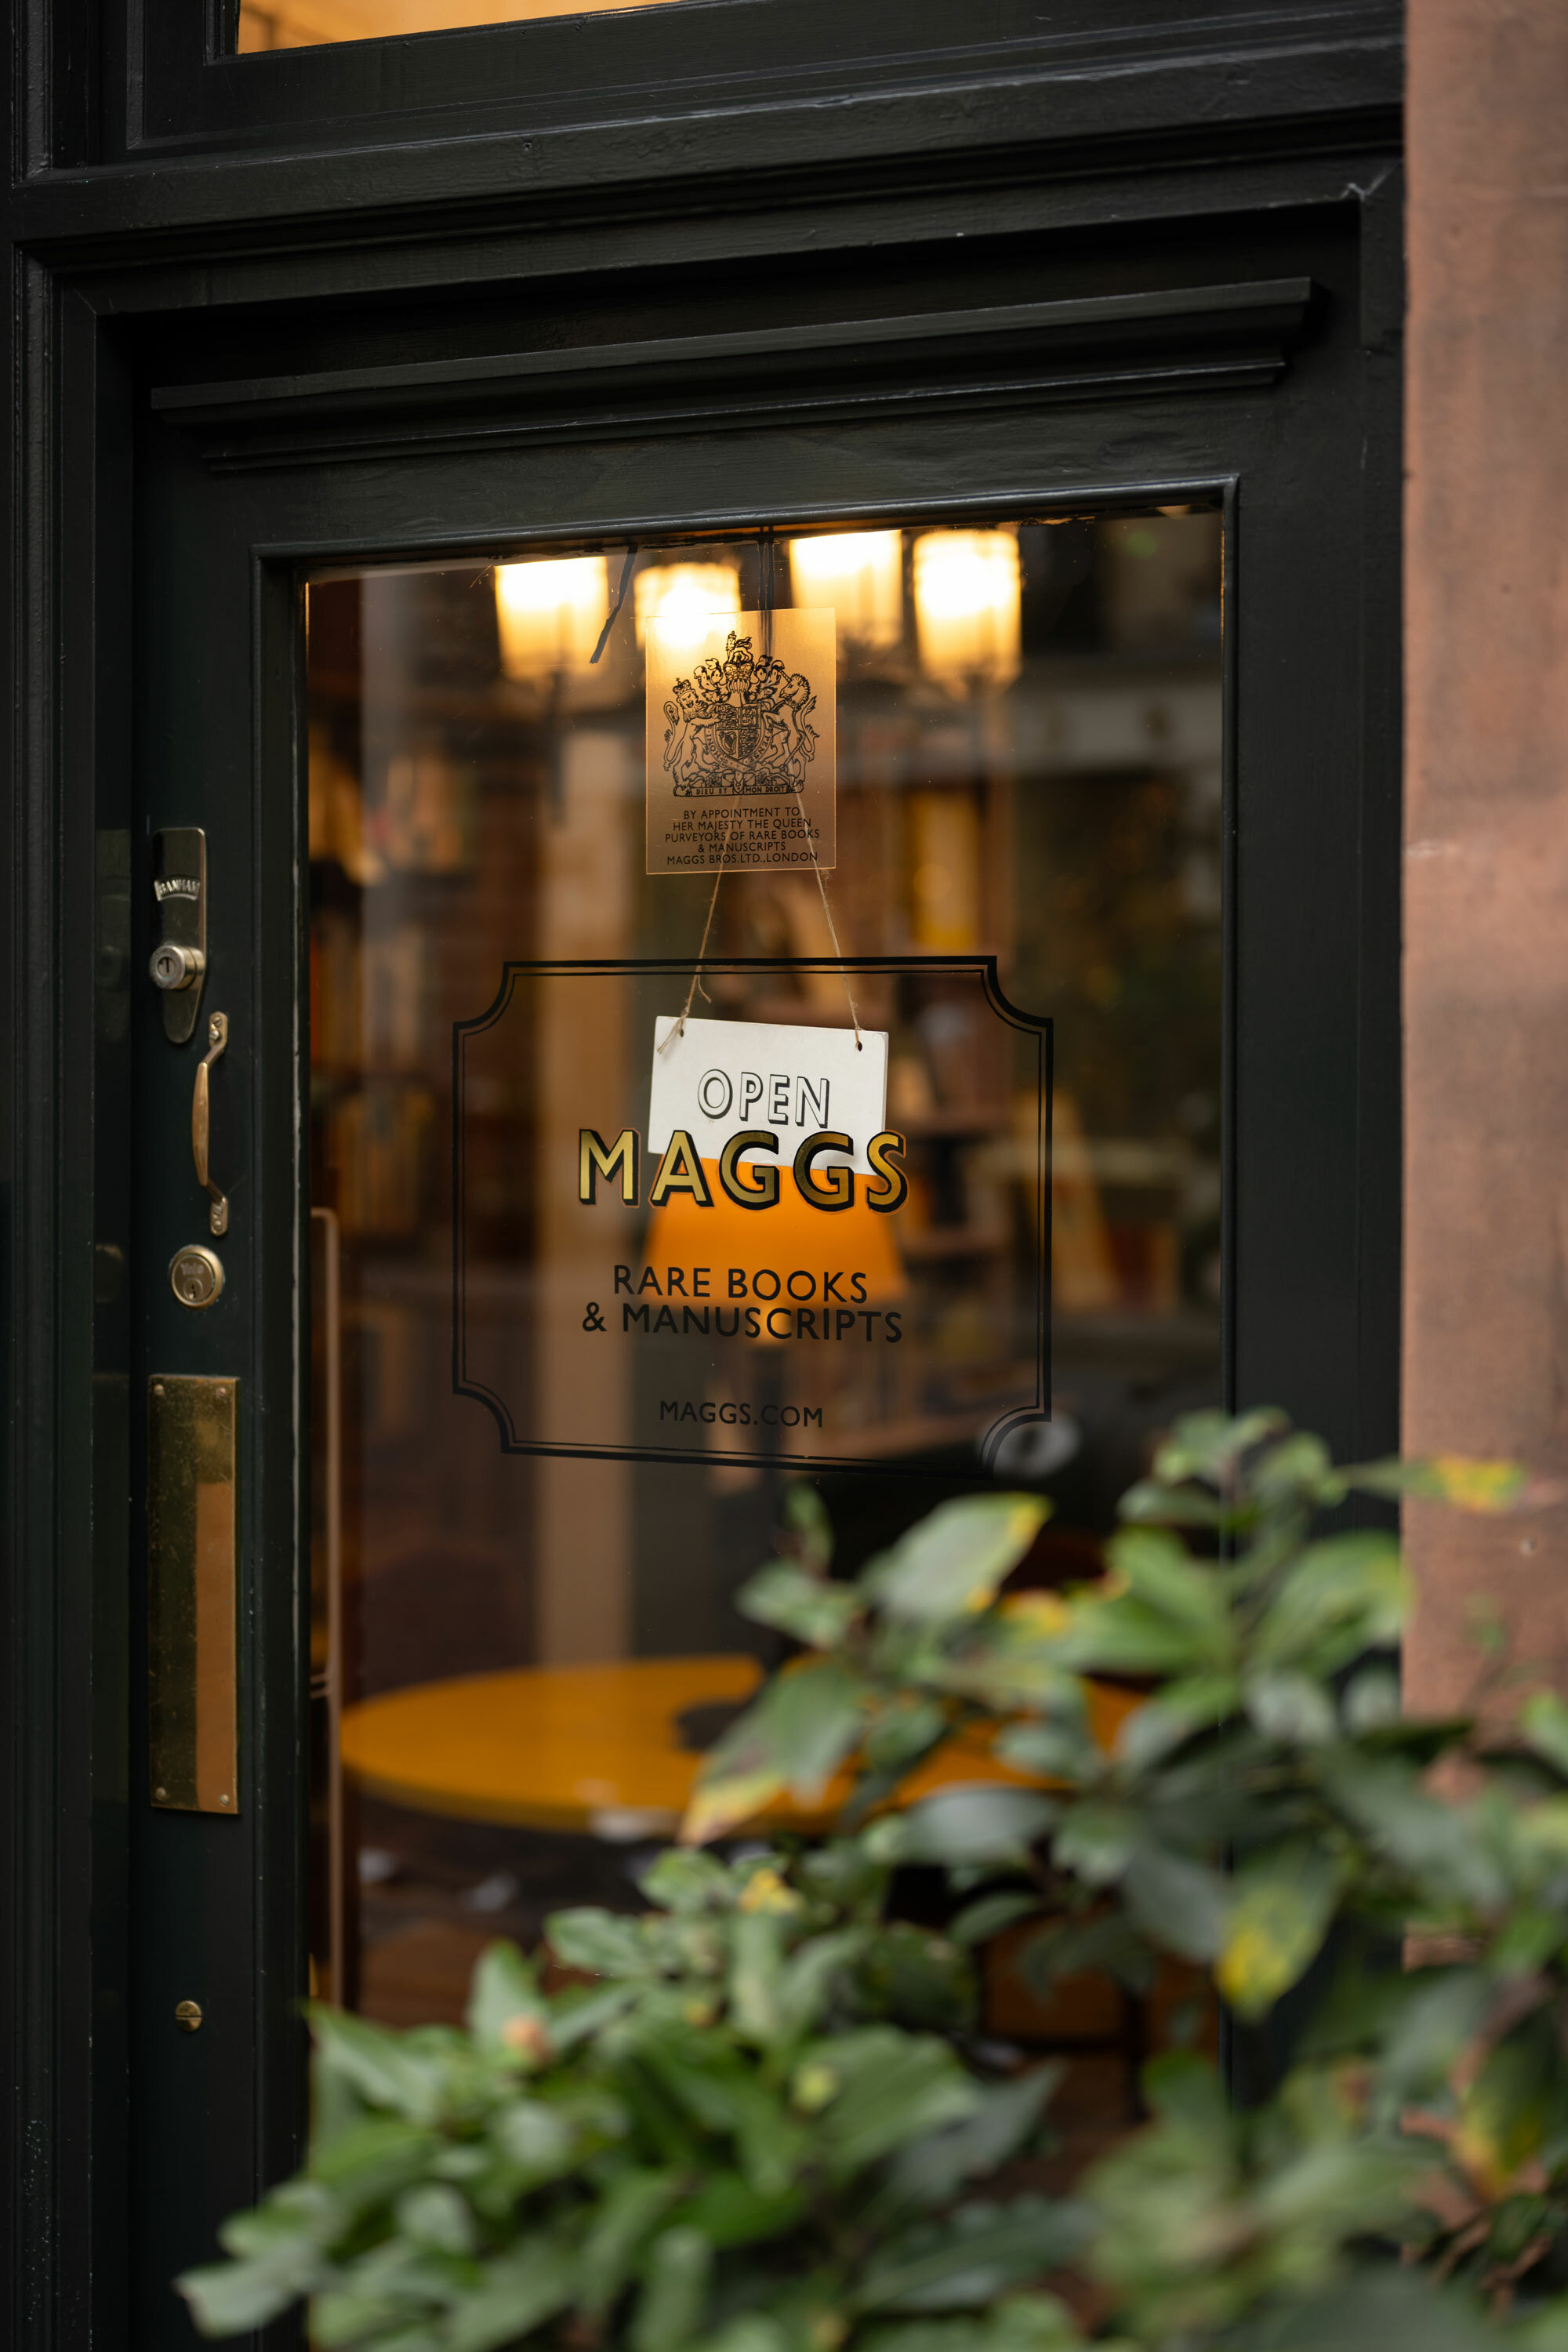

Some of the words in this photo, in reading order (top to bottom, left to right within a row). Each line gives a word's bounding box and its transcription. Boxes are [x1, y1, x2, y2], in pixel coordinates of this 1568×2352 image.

[684, 811, 696, 820] BY
[701, 808, 780, 818] APPOINTMENT
[785, 807, 800, 816] TO
[673, 822, 694, 831] HER
[698, 820, 743, 832] MAJESTY
[747, 819, 768, 829] THE
[772, 818, 811, 828] QUEEN
[666, 831, 726, 843] PURVEYORS
[730, 831, 745, 840] OF
[749, 830, 777, 840] RARE
[781, 829, 820, 839] BOOKS
[698, 844, 705, 853] &
[709, 841, 786, 852] MANUSCRIPTS
[666, 855, 705, 865] MAGGS
[698, 1069, 829, 1129] OPEN
[579, 1129, 909, 1214] MAGGS
[614, 1265, 710, 1298] RARE
[728, 1269, 868, 1304] BOOKS
[582, 1301, 608, 1332] &
[622, 1302, 903, 1344] MANUSCRIPTS
[659, 1400, 824, 1428] MAGGS.COM
